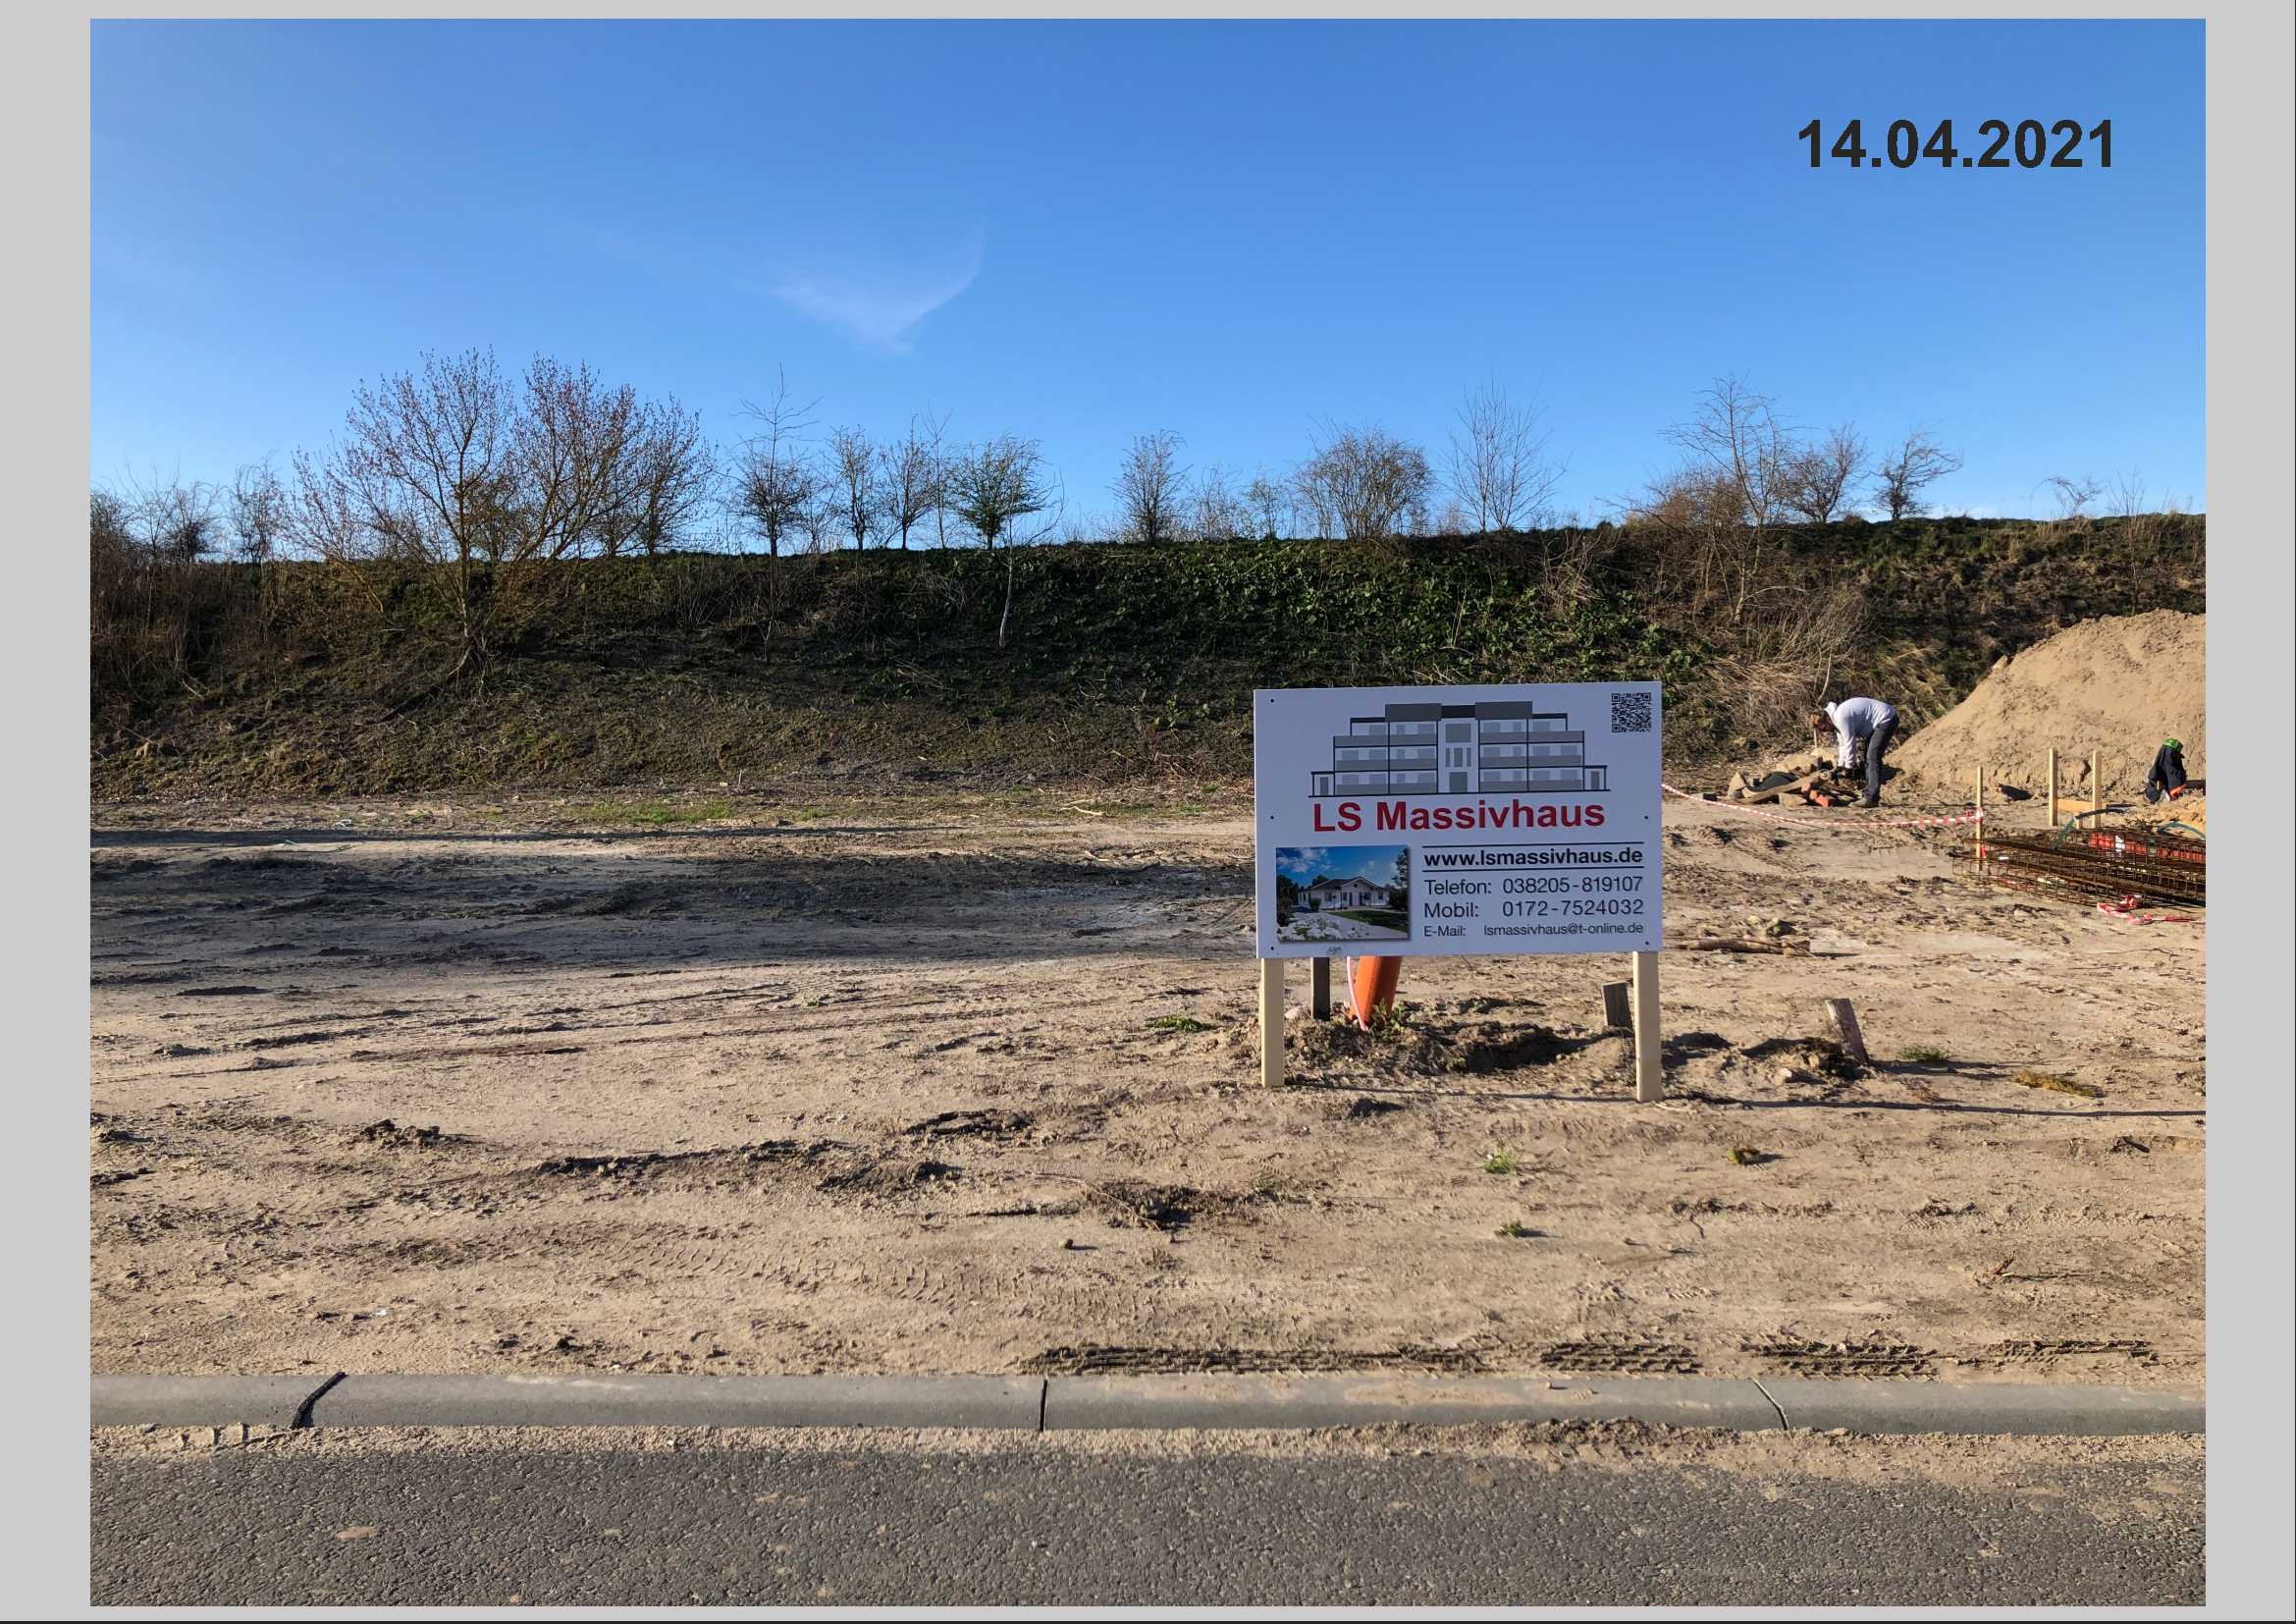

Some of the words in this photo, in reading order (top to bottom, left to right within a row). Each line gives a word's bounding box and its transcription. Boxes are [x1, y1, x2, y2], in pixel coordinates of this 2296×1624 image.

[1313, 801, 1362, 832] LS
[1376, 799, 1605, 831] Massivhaus
[1424, 847, 1643, 866] www.lsmassivhaus.de
[1424, 879, 1492, 894] Telefon:
[1502, 876, 1642, 893] 038205-819107
[1424, 902, 1478, 918] Mobil:
[1502, 899, 1643, 917] 0172-7524032
[1424, 926, 1466, 937] E-Mail:
[1483, 922, 1643, 936] lsmassivhaus@t-online.de
